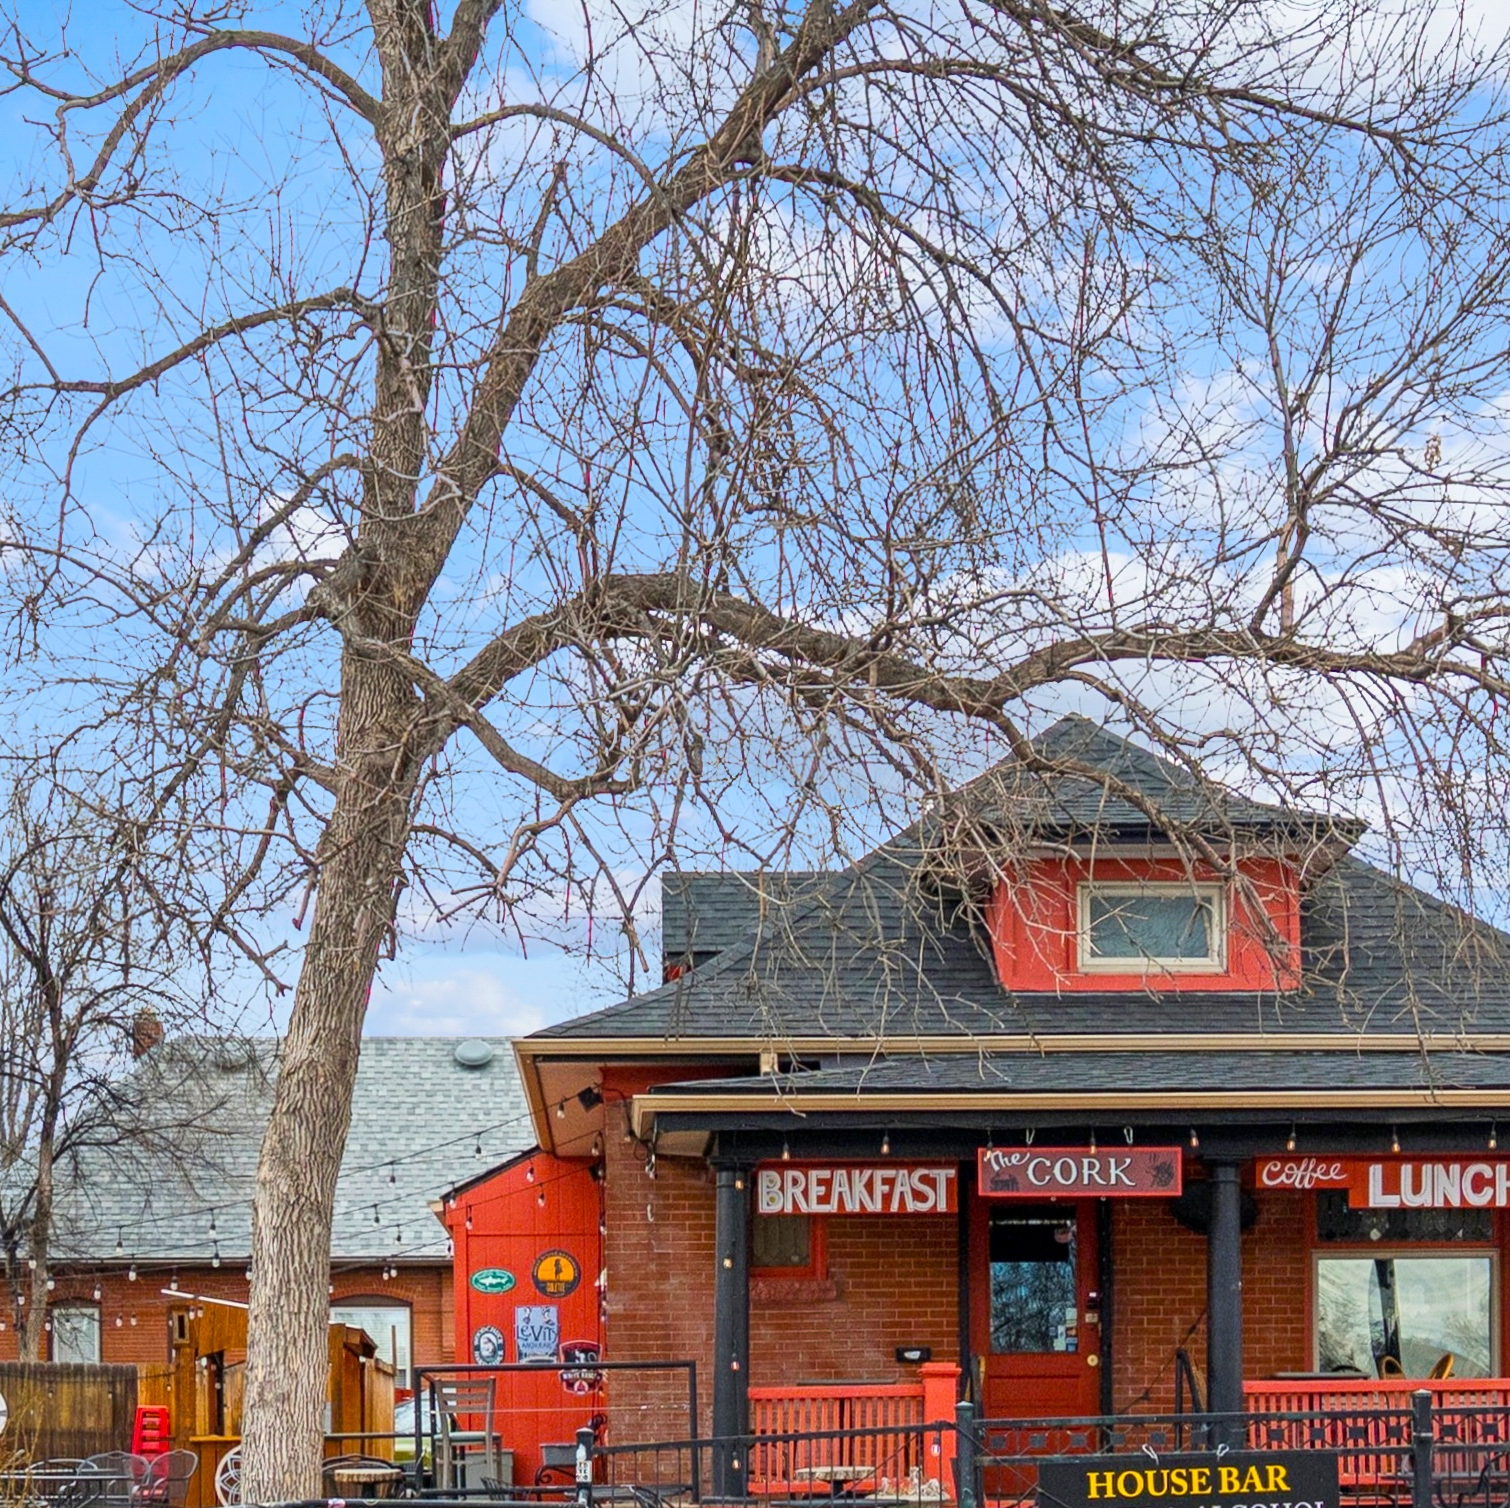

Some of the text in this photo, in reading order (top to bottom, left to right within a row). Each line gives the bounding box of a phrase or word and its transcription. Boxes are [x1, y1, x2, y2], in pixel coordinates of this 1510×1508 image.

[984, 1150, 1136, 1187] The CORK
[1261, 1158, 1348, 1189] Coffee
[758, 1168, 956, 1213] BREAKFAST
[1086, 1464, 1291, 1499] HOUSE BAR
